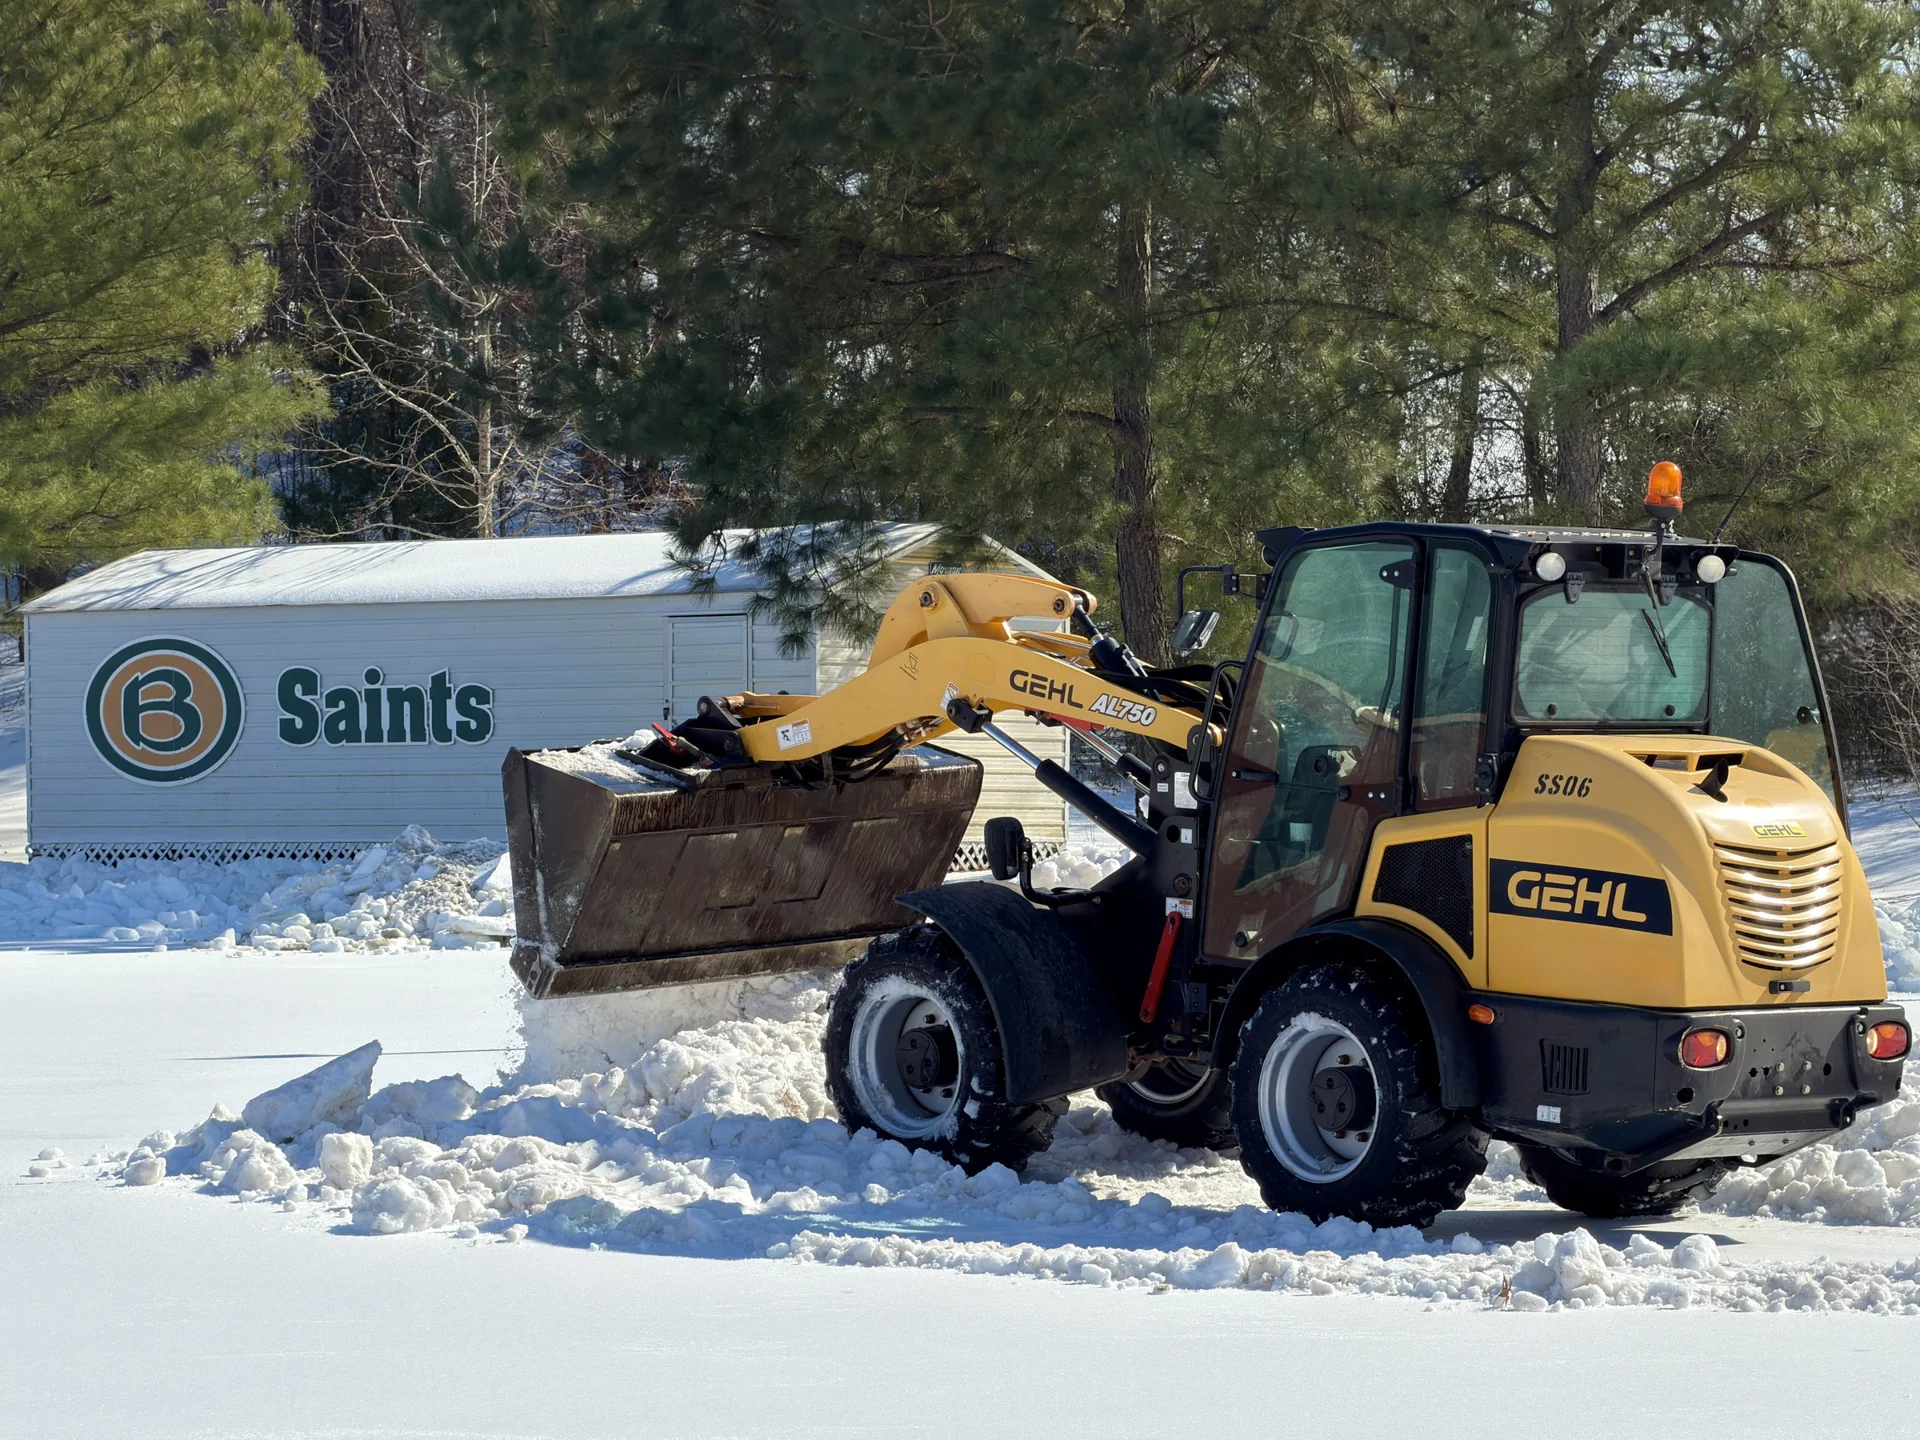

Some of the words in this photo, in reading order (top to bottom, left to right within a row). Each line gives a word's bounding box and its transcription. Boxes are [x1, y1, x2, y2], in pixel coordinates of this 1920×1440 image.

[122, 666, 203, 754] B
[277, 665, 494, 748] Saints
[1009, 669, 1084, 709] GEHL
[1088, 692, 1158, 727] AL750
[1534, 773, 1593, 798] SS06
[1753, 824, 1802, 836] GEHL
[1507, 870, 1647, 923] GEHL
